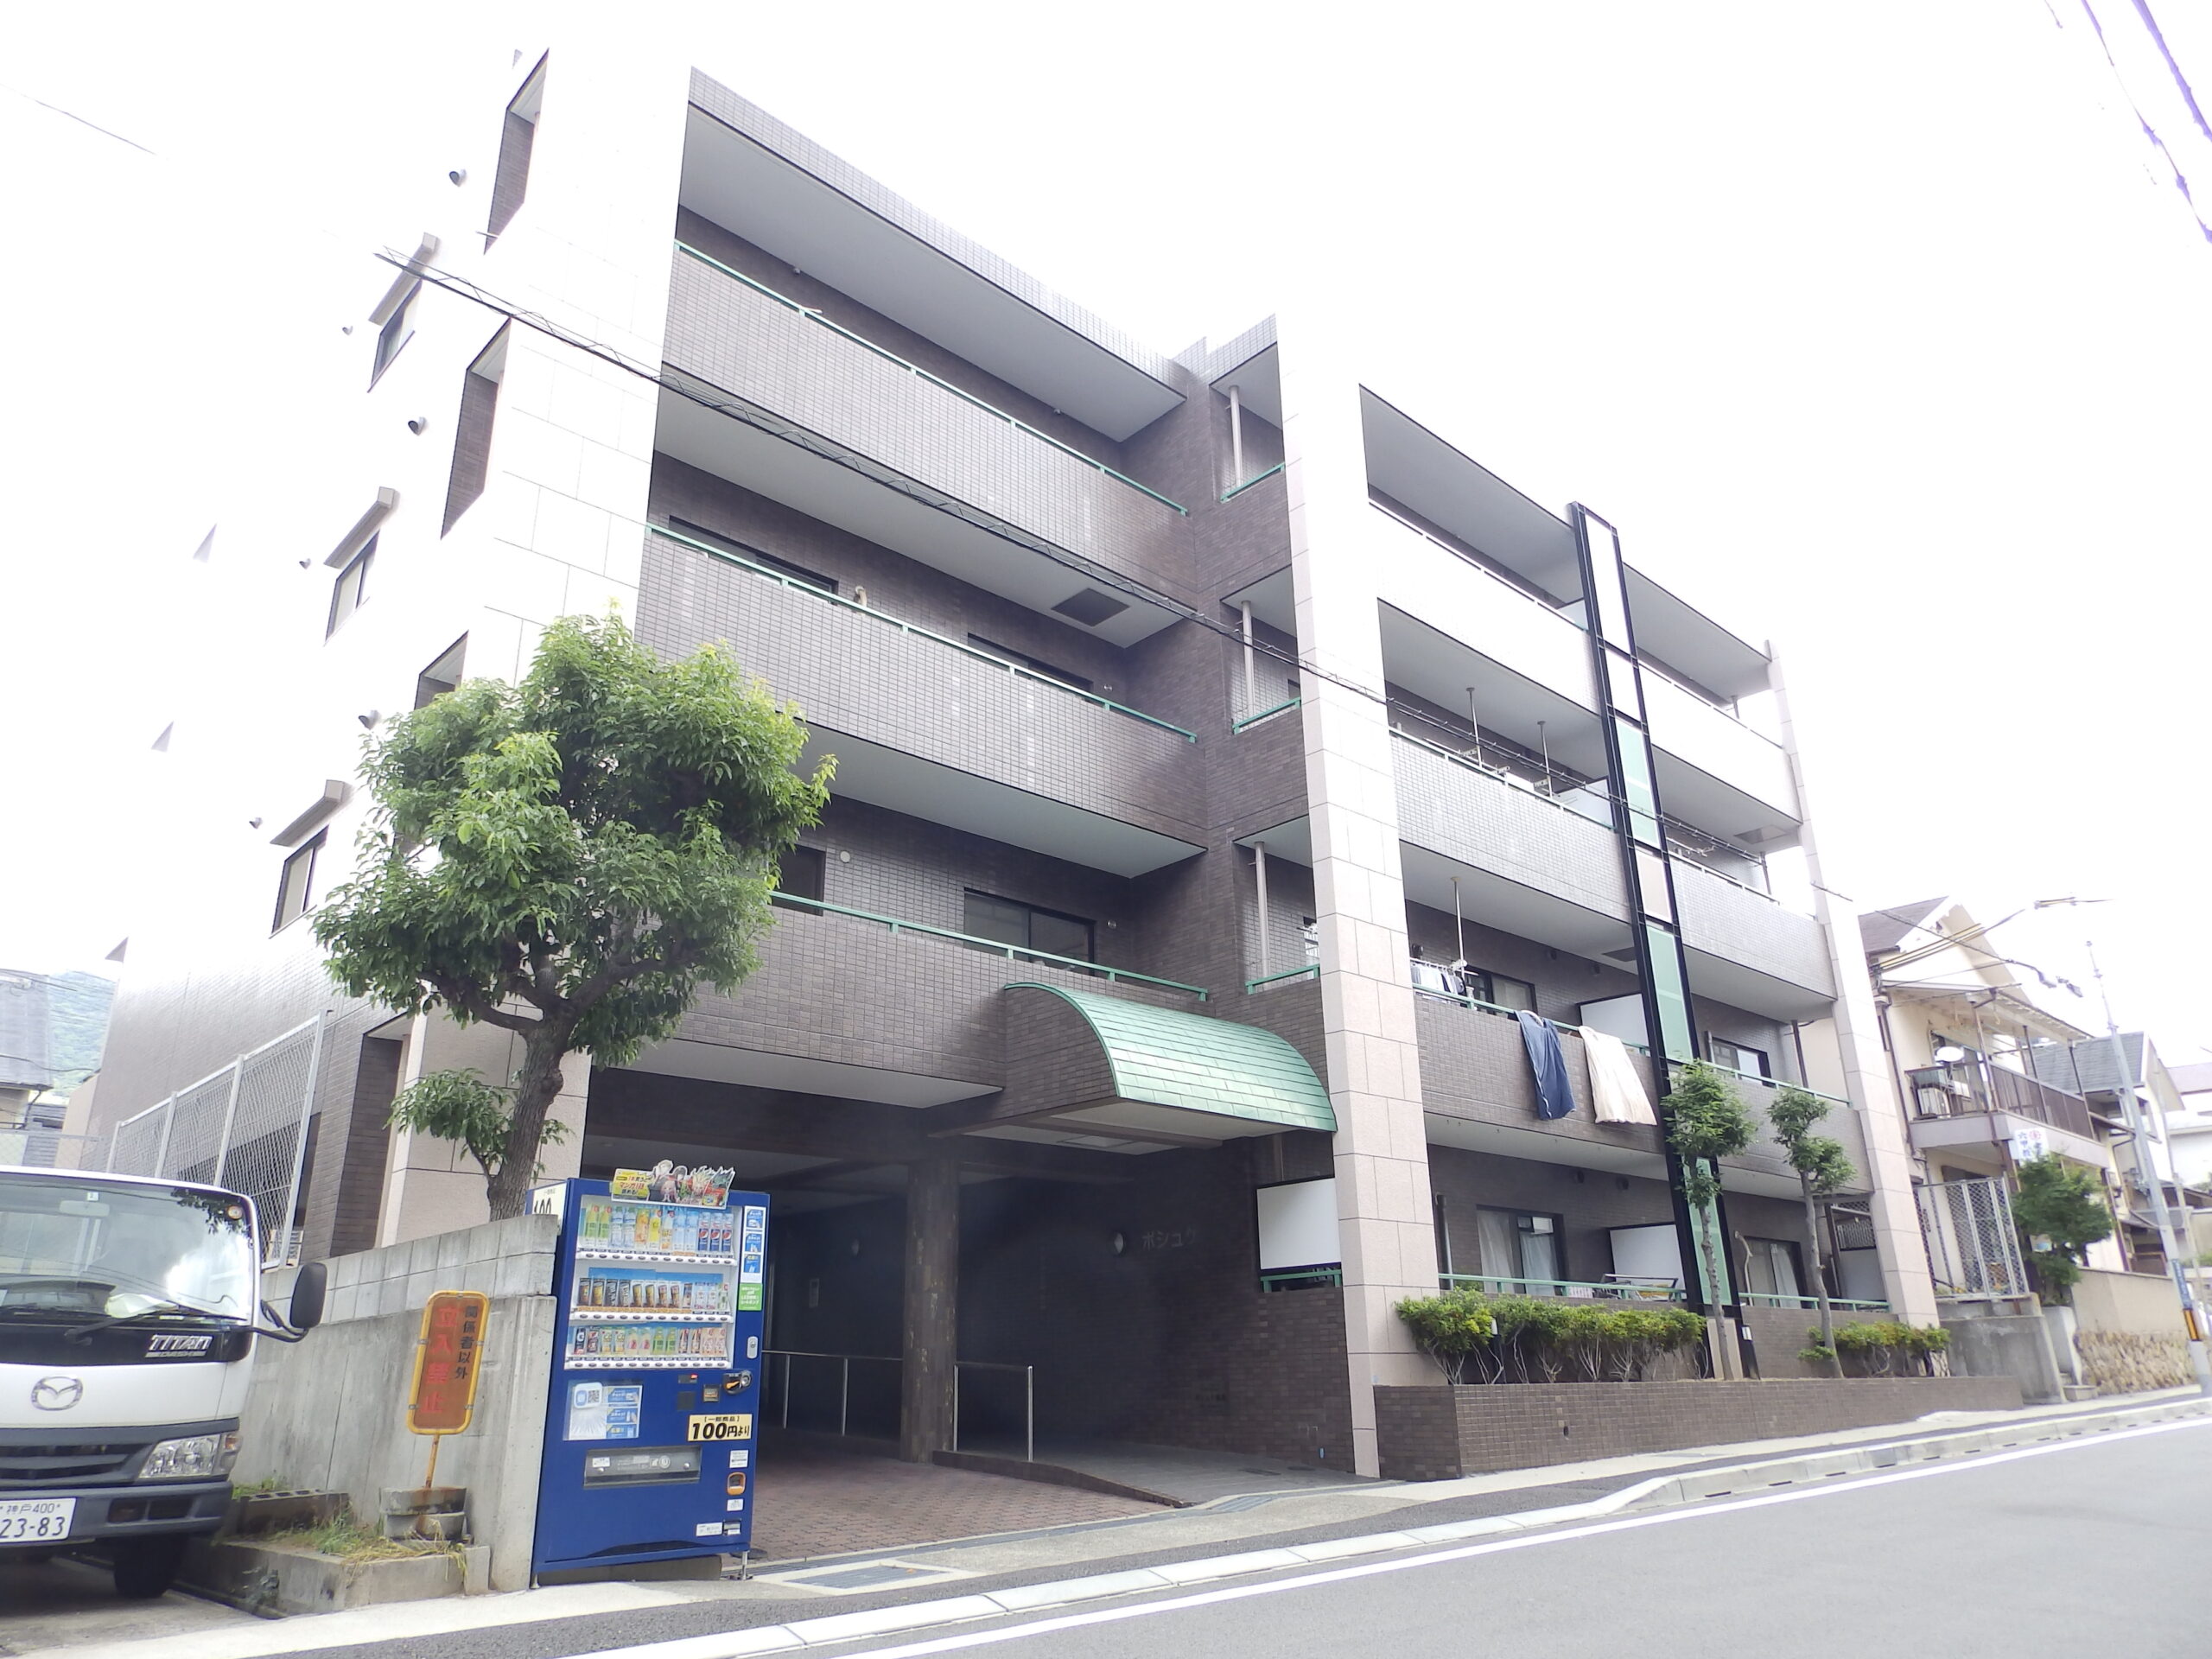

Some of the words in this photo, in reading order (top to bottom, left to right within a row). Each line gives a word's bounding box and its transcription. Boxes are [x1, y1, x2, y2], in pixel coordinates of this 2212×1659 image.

[149, 1334, 213, 1351] TITAN
[454, 1306, 479, 1379] 関係者以外
[420, 1305, 463, 1414] 立入禁止
[692, 1422, 750, 1440] 100円より
[0, 1516, 66, 1537] 23-83
